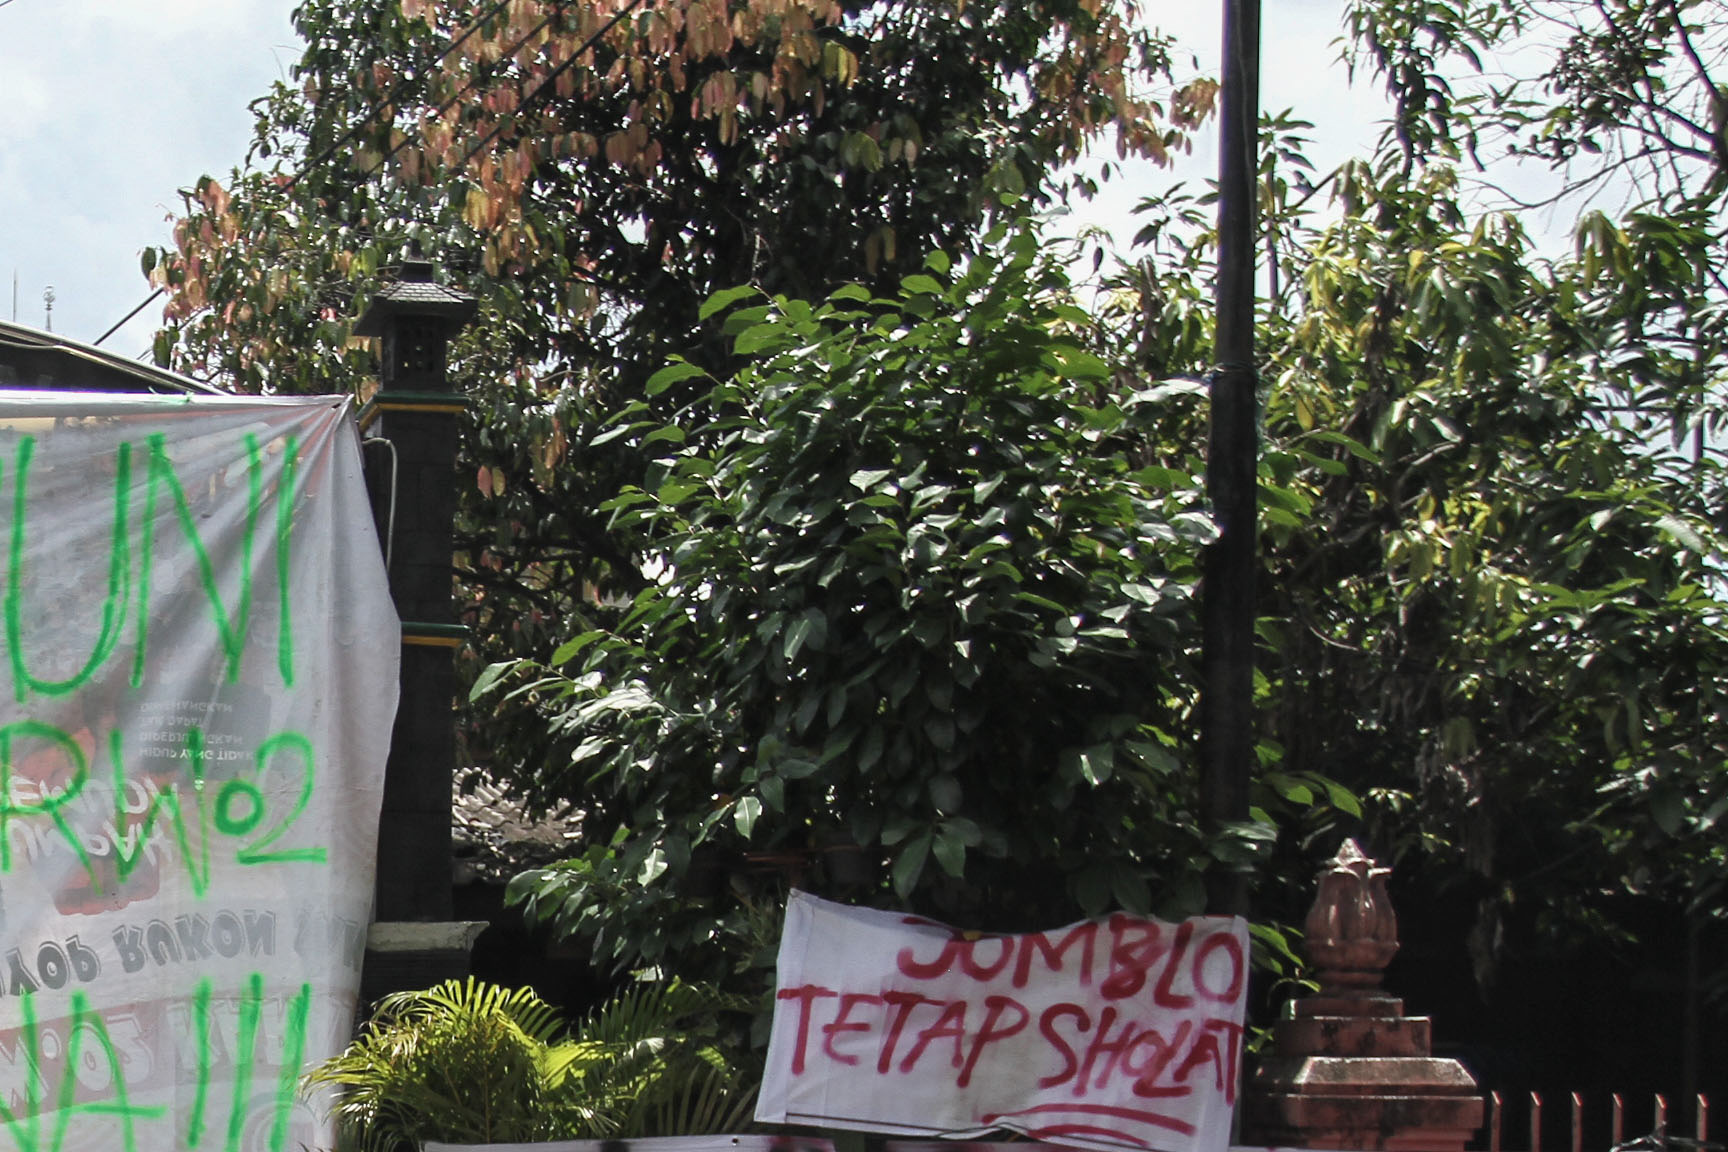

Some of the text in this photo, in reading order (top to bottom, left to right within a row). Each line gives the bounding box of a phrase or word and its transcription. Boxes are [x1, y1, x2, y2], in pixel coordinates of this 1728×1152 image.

[897, 910, 1244, 1010] JOMBLO
[776, 984, 1245, 1108] TETAP SHOLAT
